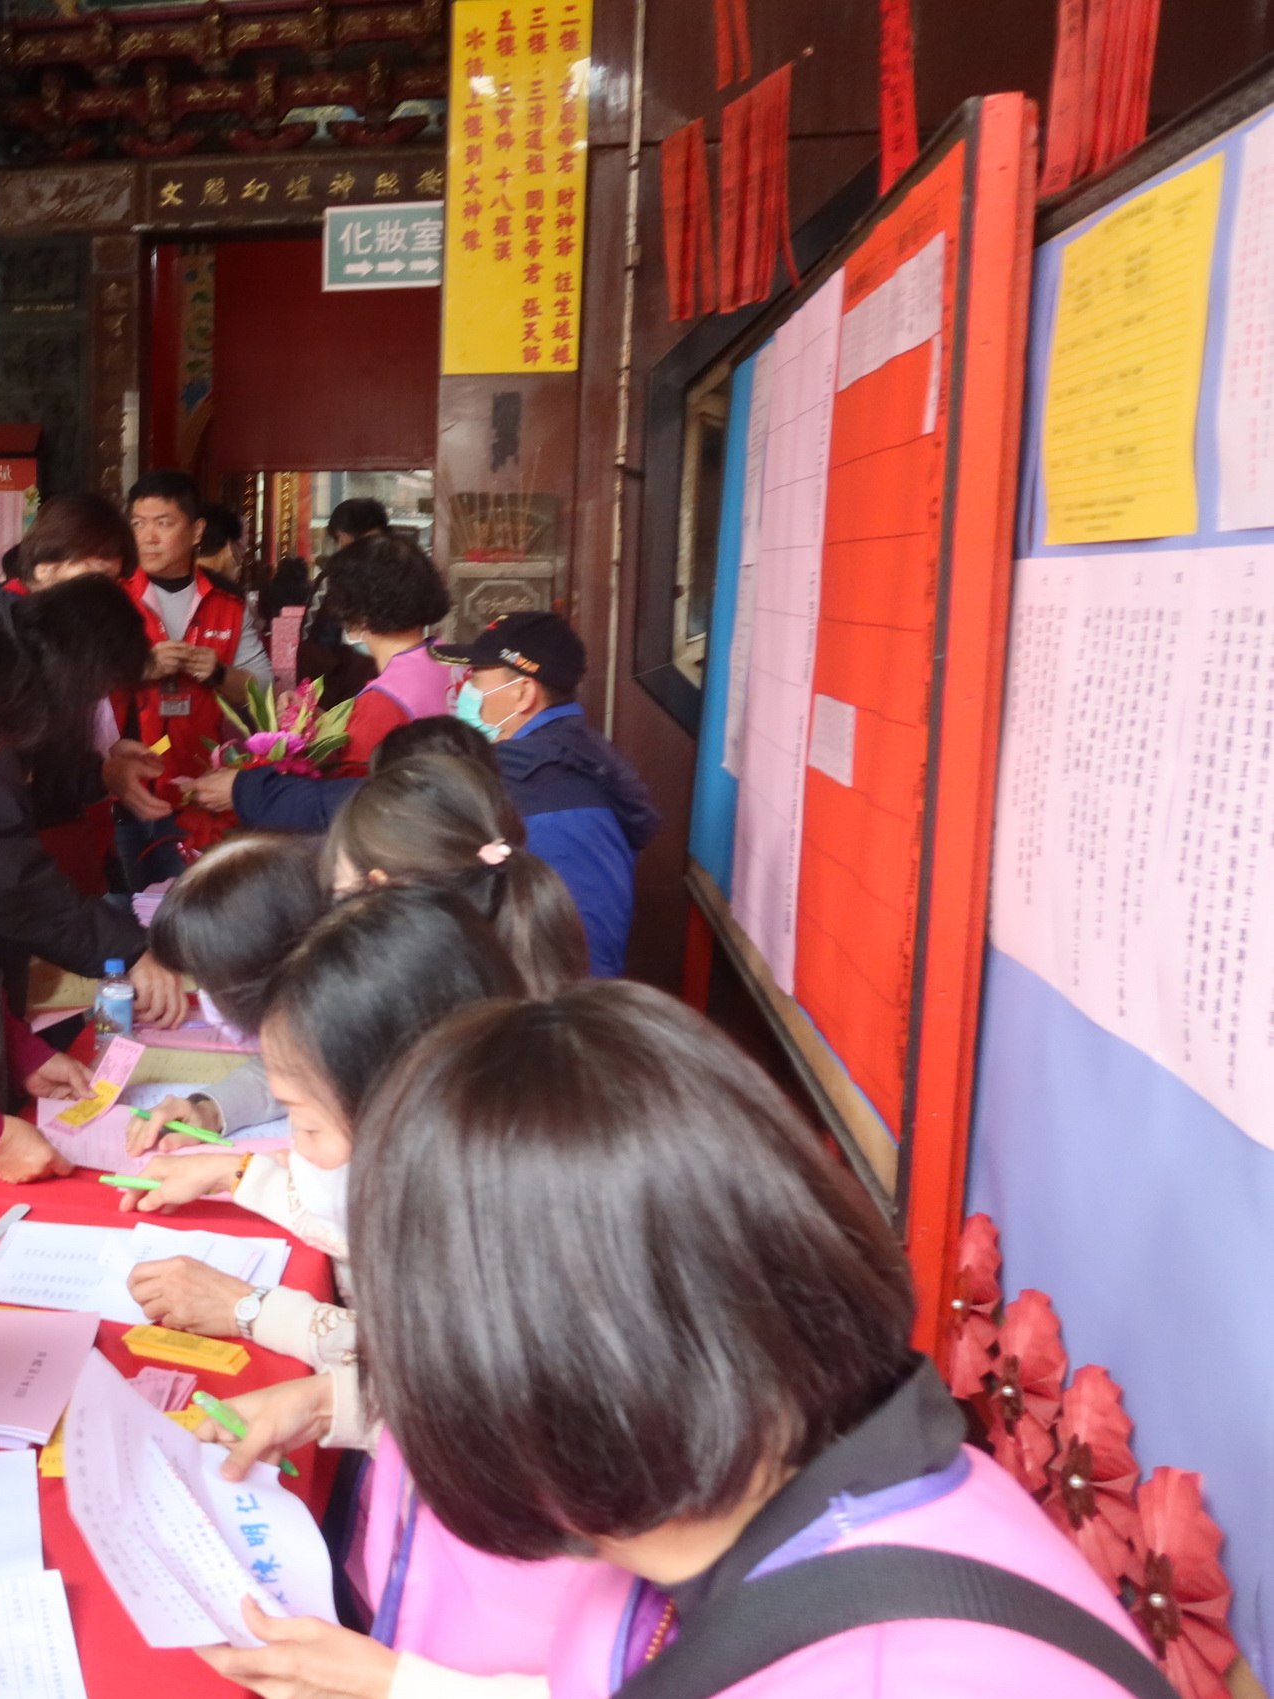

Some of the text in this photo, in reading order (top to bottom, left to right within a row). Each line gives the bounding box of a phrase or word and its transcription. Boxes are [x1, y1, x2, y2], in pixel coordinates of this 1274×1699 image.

[339, 217, 443, 256] 化妝室
[236, 1492, 289, 1605] 陳明仁
